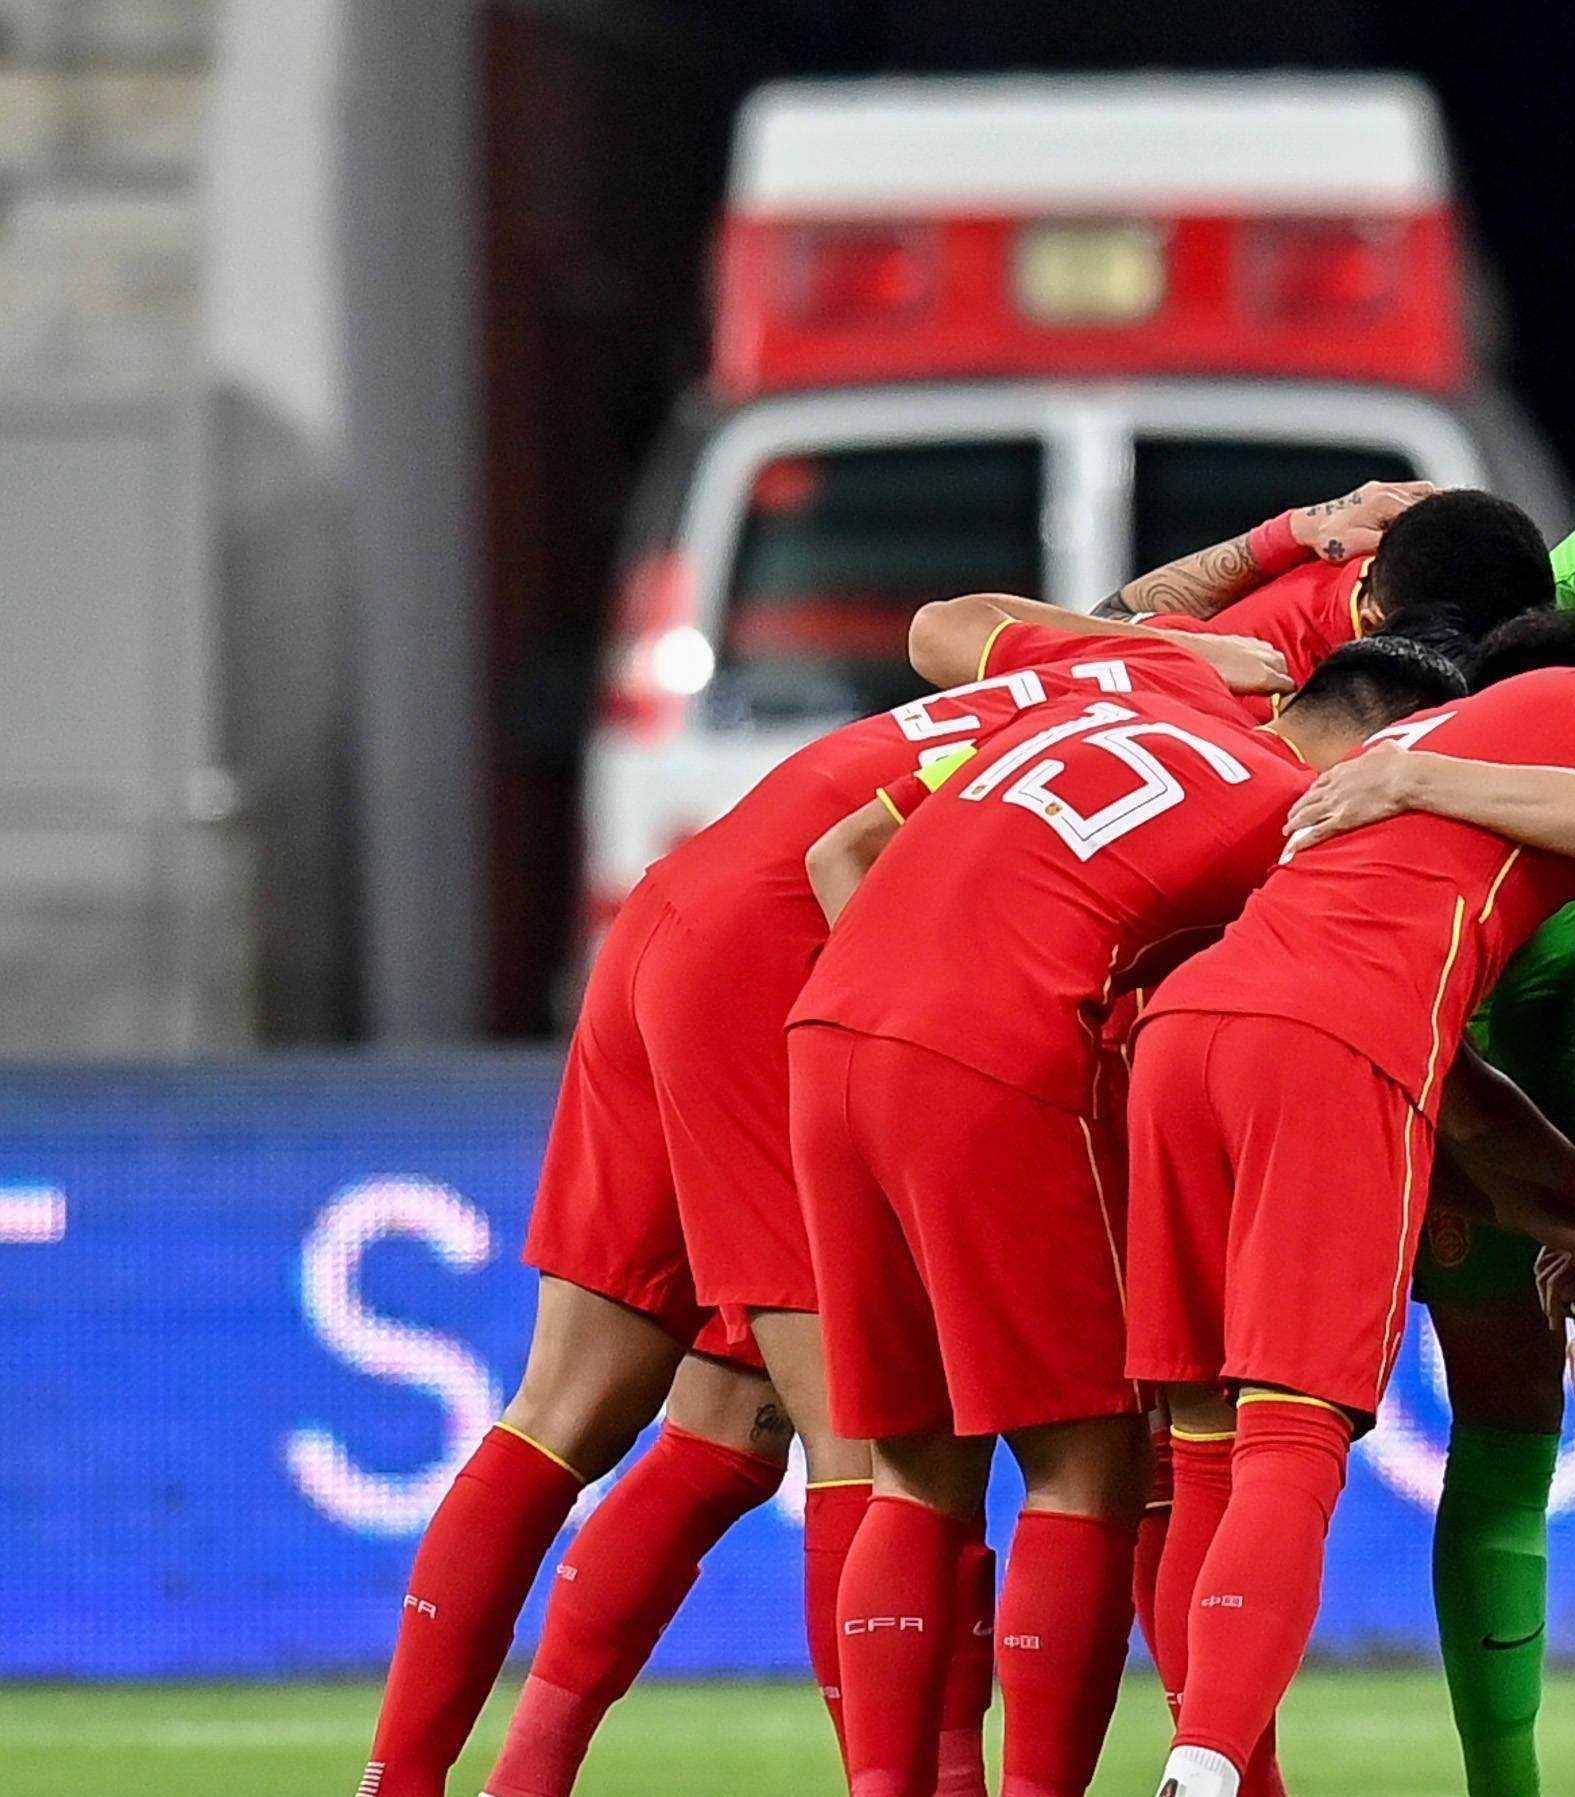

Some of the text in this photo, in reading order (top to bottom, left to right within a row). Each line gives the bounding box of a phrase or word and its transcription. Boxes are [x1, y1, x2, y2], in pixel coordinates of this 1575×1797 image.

[958, 700, 1252, 863] 15
[402, 1593, 437, 1620] FA
[844, 1616, 924, 1636] CFA
